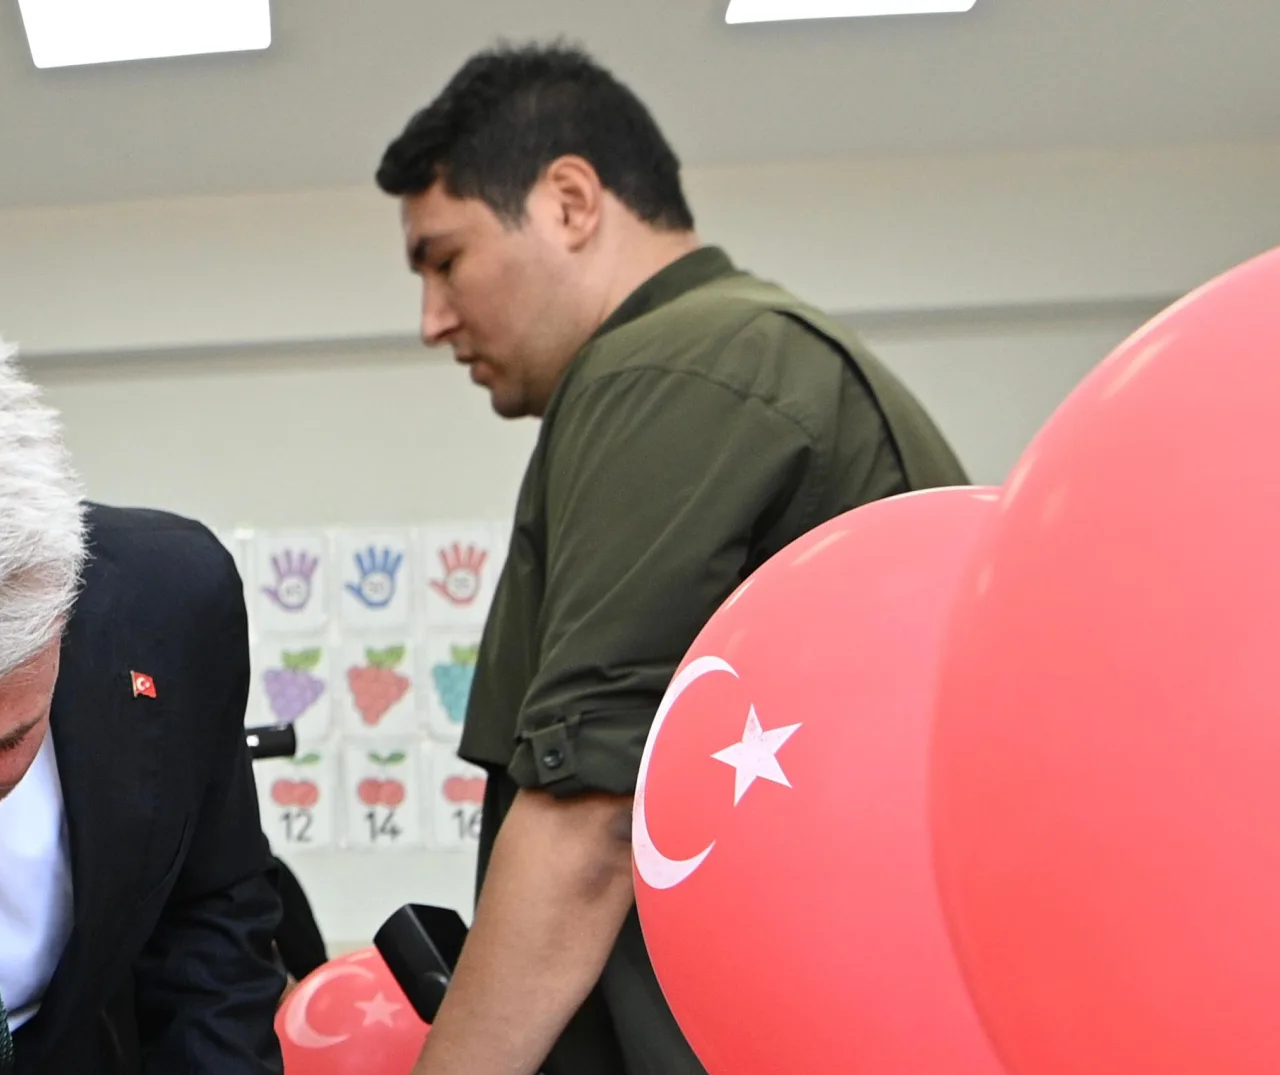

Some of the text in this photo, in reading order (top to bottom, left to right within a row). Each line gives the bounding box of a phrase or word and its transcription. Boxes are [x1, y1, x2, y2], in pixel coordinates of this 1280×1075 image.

[280, 808, 312, 842] 12
[365, 808, 401, 842] 14
[452, 807, 482, 839] 16
